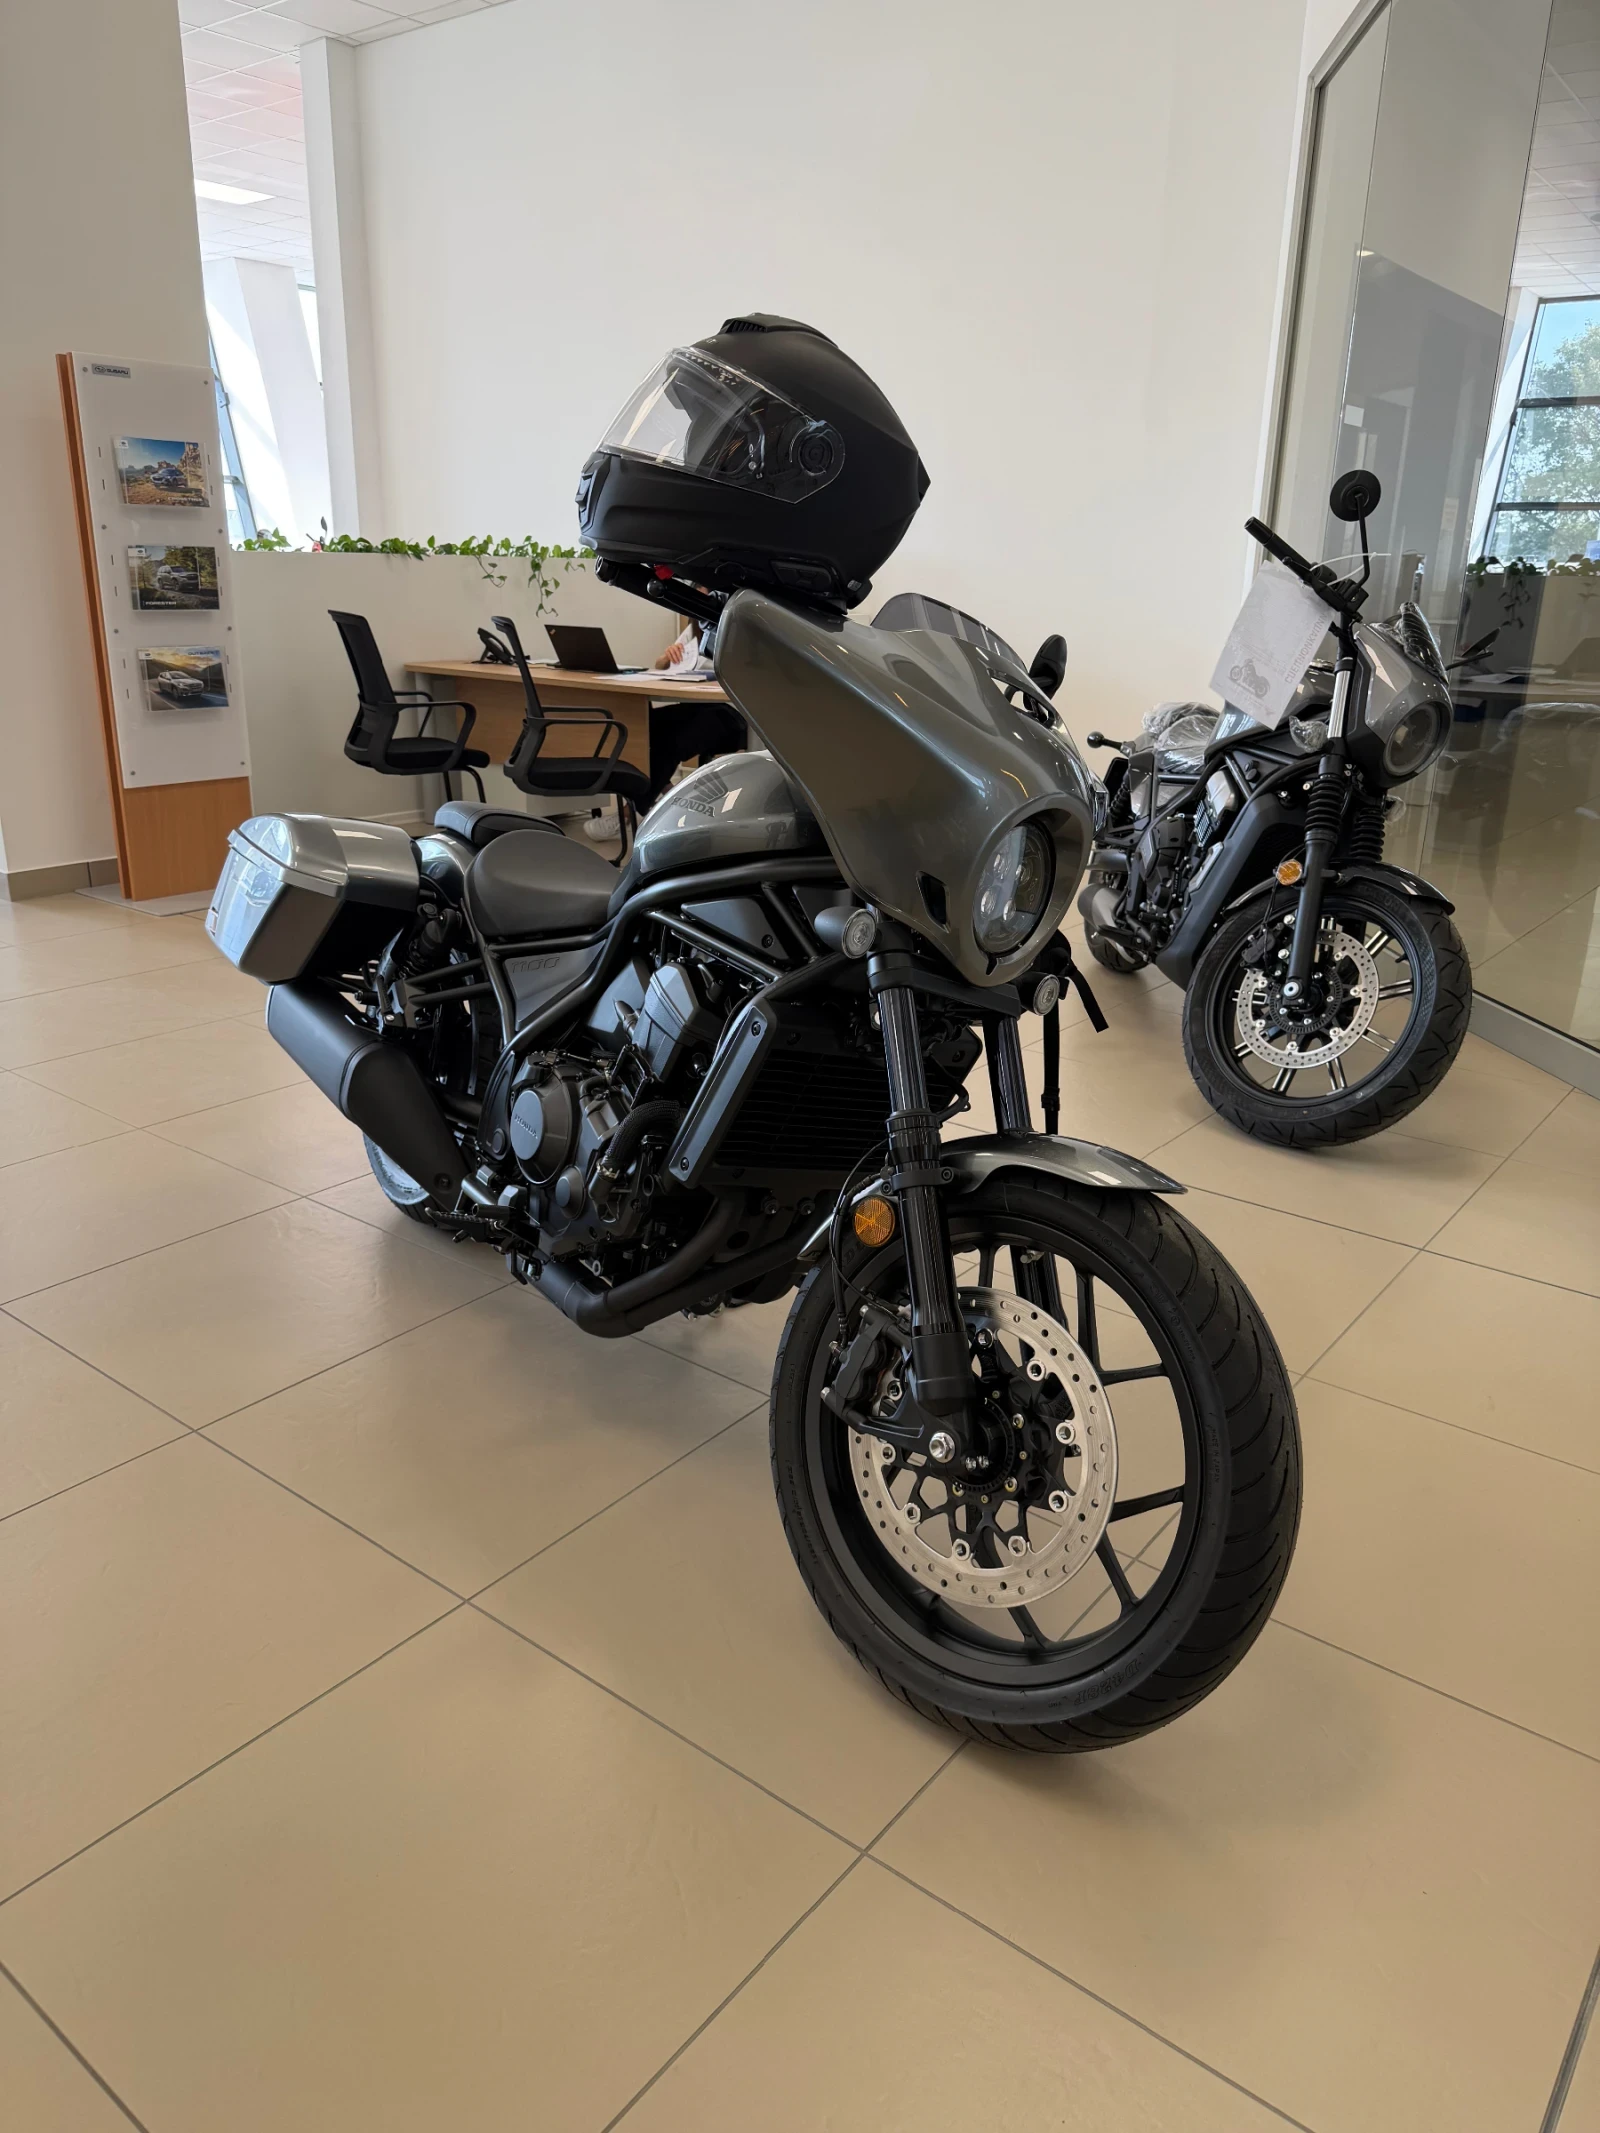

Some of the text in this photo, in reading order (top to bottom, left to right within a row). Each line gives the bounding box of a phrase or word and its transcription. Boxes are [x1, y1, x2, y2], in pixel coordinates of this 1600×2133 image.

[671, 796, 716, 818] HONDA
[511, 956, 560, 974] 1100
[514, 1113, 538, 1139] HONDA
